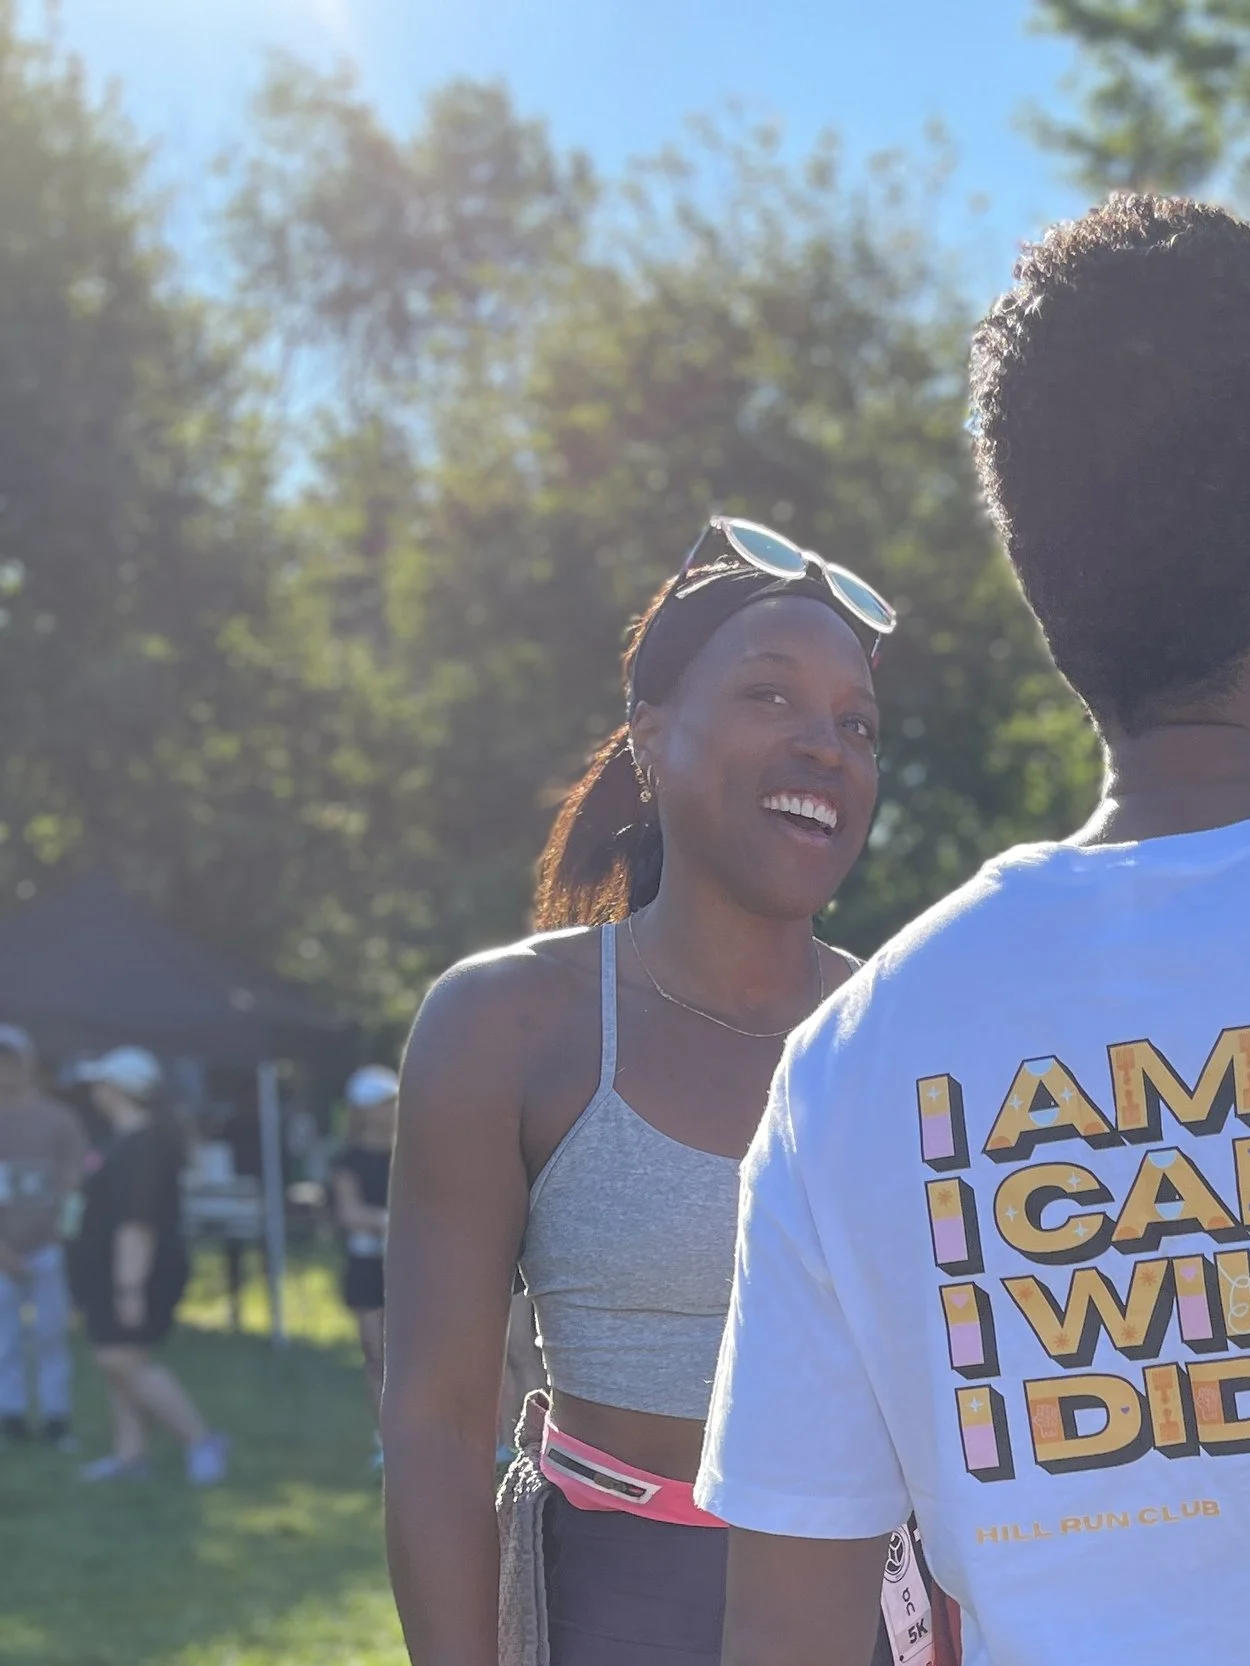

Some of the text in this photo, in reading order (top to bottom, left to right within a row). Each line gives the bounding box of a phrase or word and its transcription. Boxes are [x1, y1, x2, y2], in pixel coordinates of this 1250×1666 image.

[916, 1073, 970, 1172] I
[925, 1176, 985, 1274] I
[939, 1281, 1001, 1379] I
[955, 1384, 1015, 1483] I
[976, 1499, 1221, 1545] HILL RUN CLUB
[908, 1618, 928, 1644] 5K
